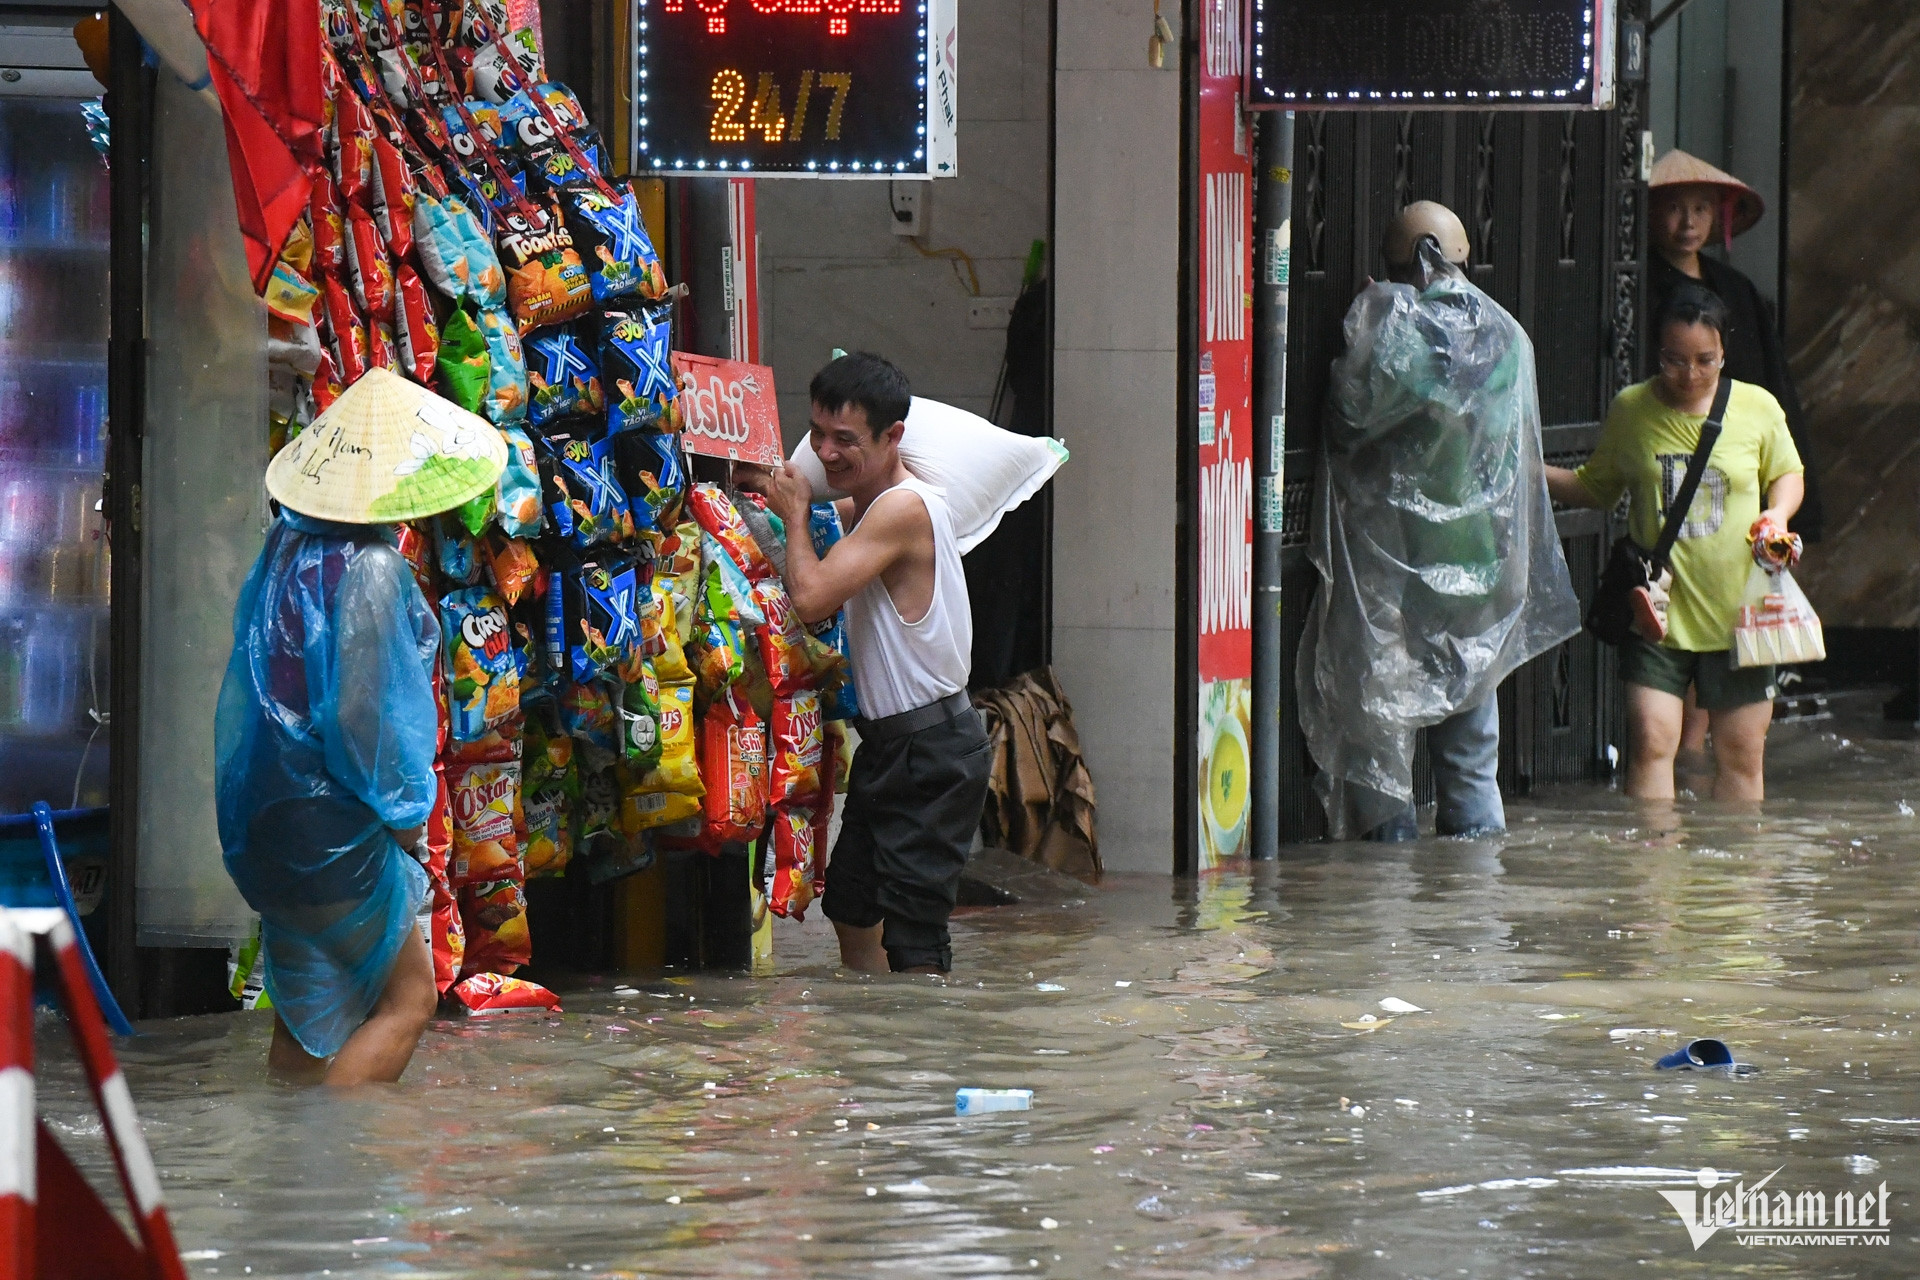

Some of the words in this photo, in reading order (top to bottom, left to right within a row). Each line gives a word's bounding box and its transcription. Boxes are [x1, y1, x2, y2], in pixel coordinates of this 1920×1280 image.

[711, 69, 852, 142] 24/7
[1206, 172, 1245, 343] DINH
[681, 370, 750, 443] ishi
[455, 776, 510, 822] O'Star
